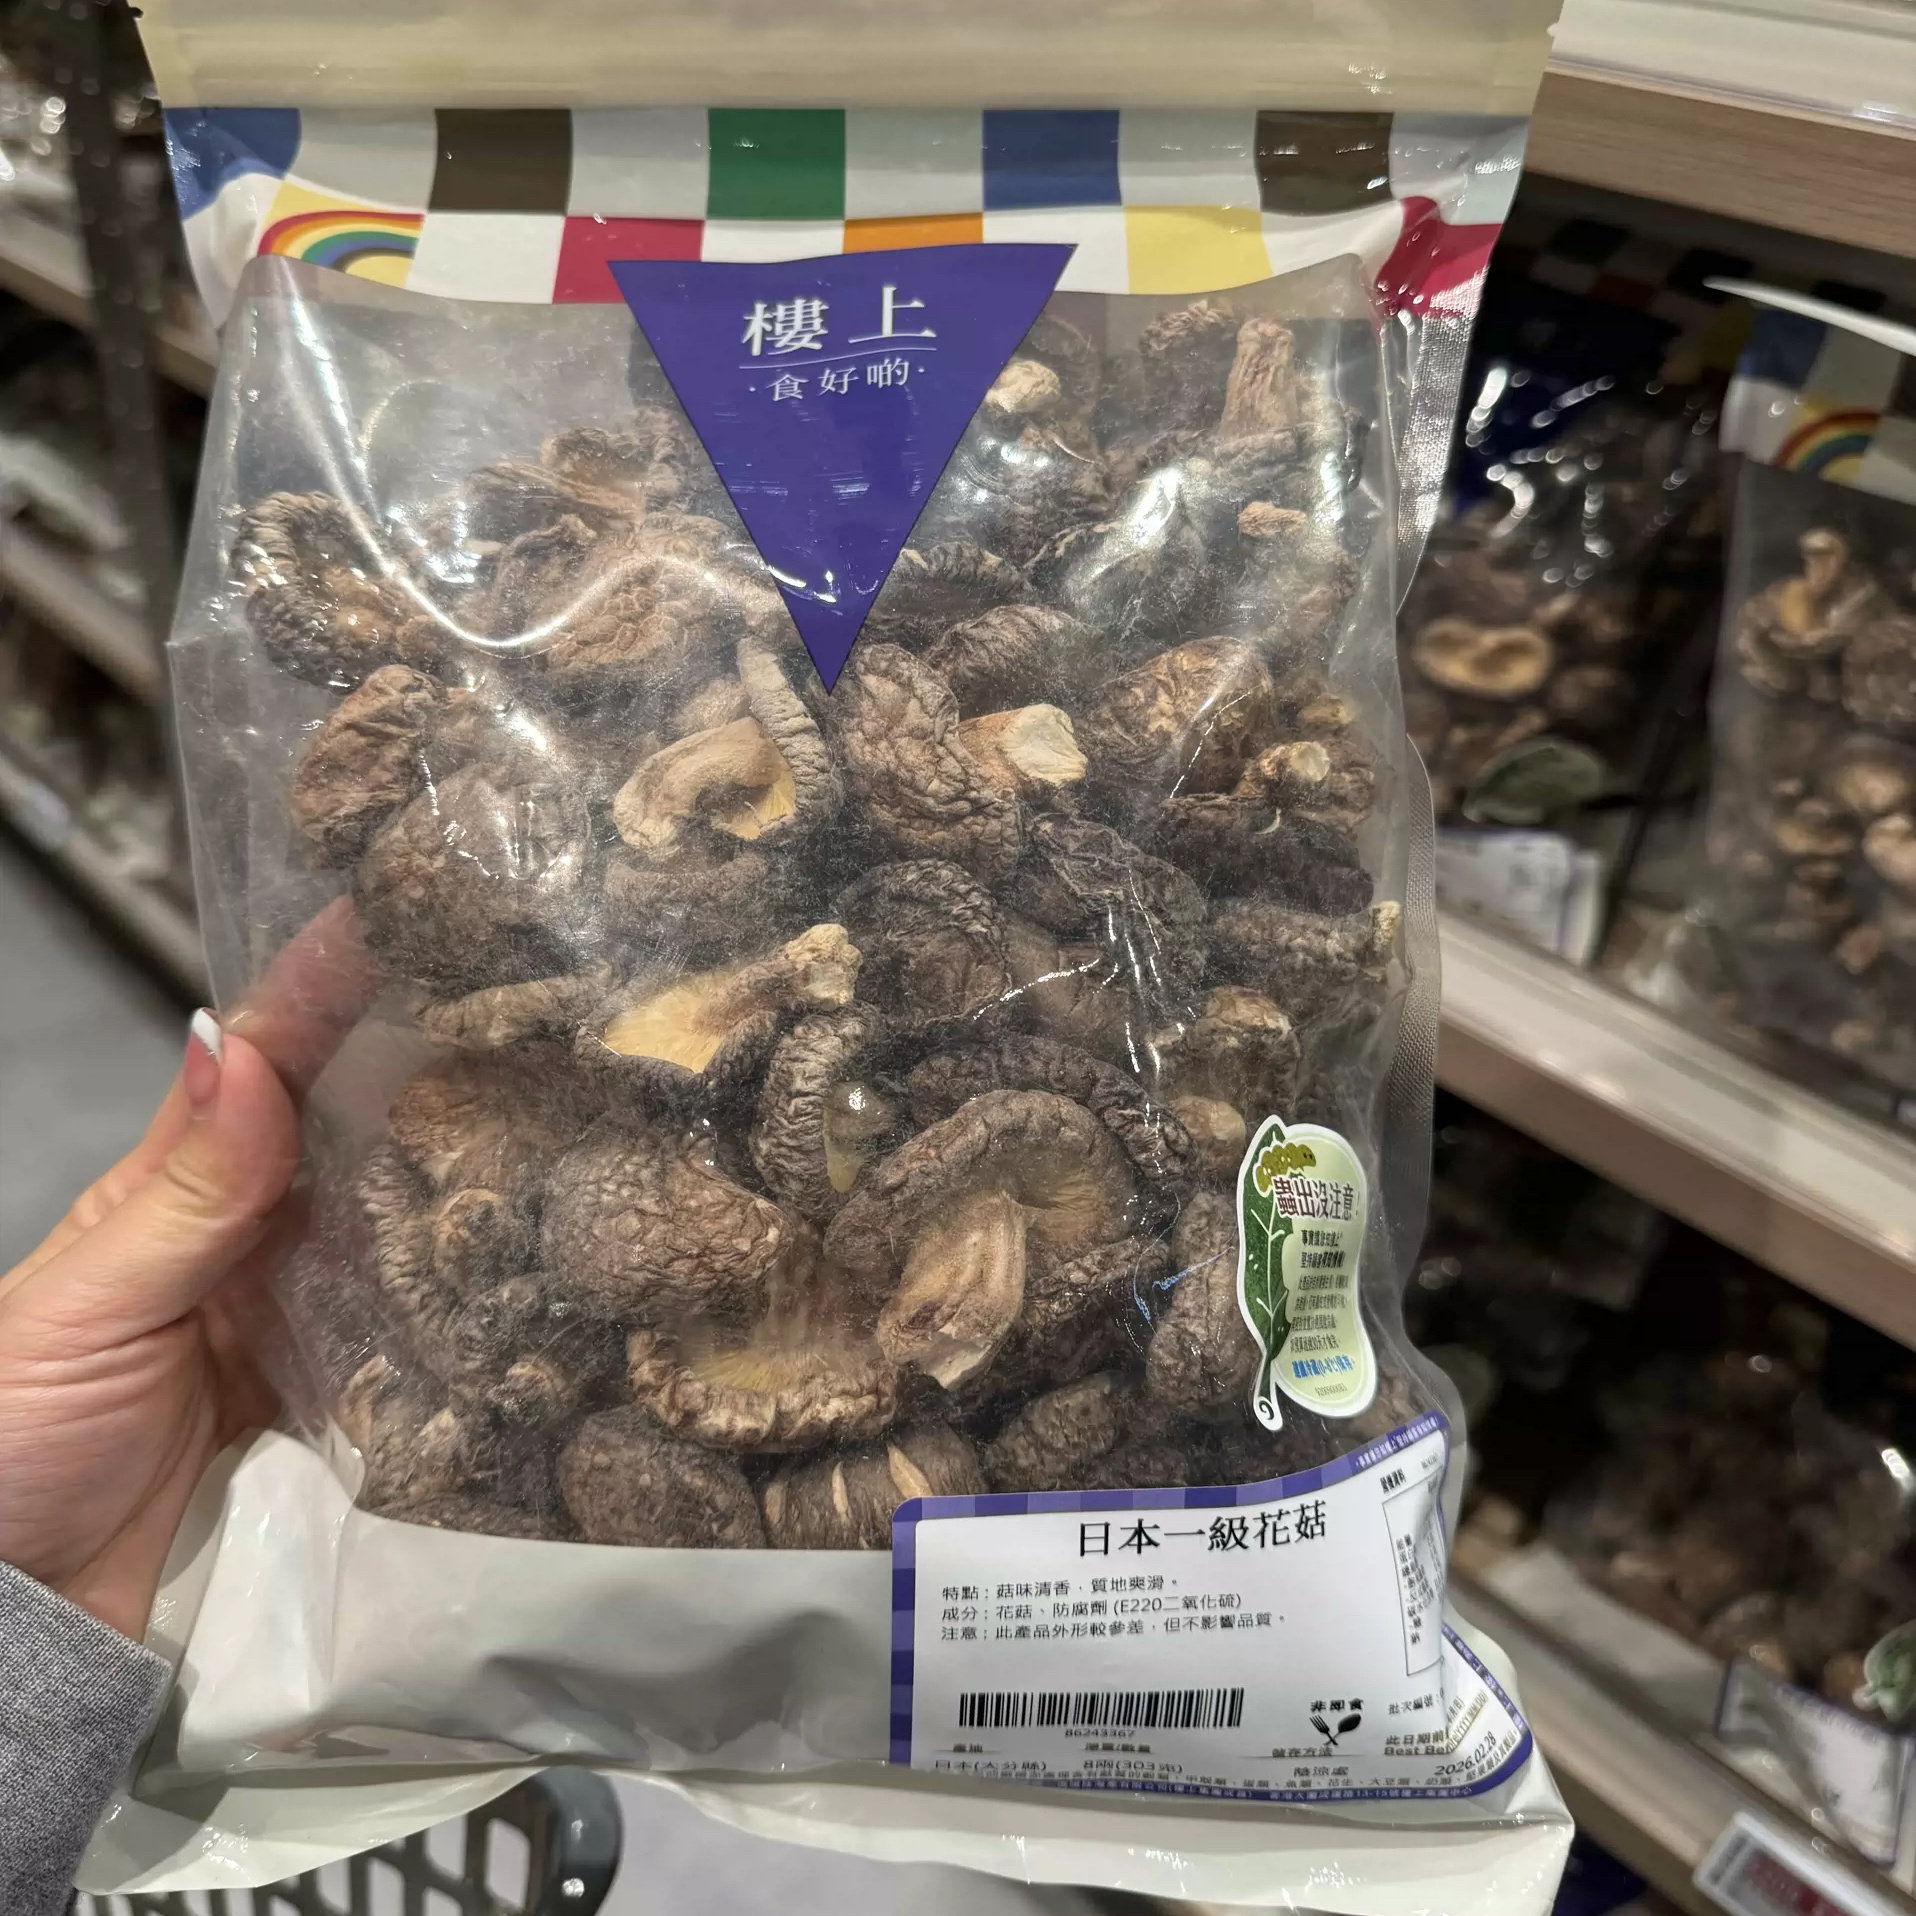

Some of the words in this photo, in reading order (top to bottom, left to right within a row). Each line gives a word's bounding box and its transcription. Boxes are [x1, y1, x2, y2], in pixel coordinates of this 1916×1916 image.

[741, 284, 937, 356] 樓上
[1079, 1500, 1328, 1558] 日本一級花菇
[1310, 1698, 1364, 1712] 非即食
[1065, 1728, 1135, 1738] 86243367
[1434, 1731, 1496, 1776] 2026.02.28
